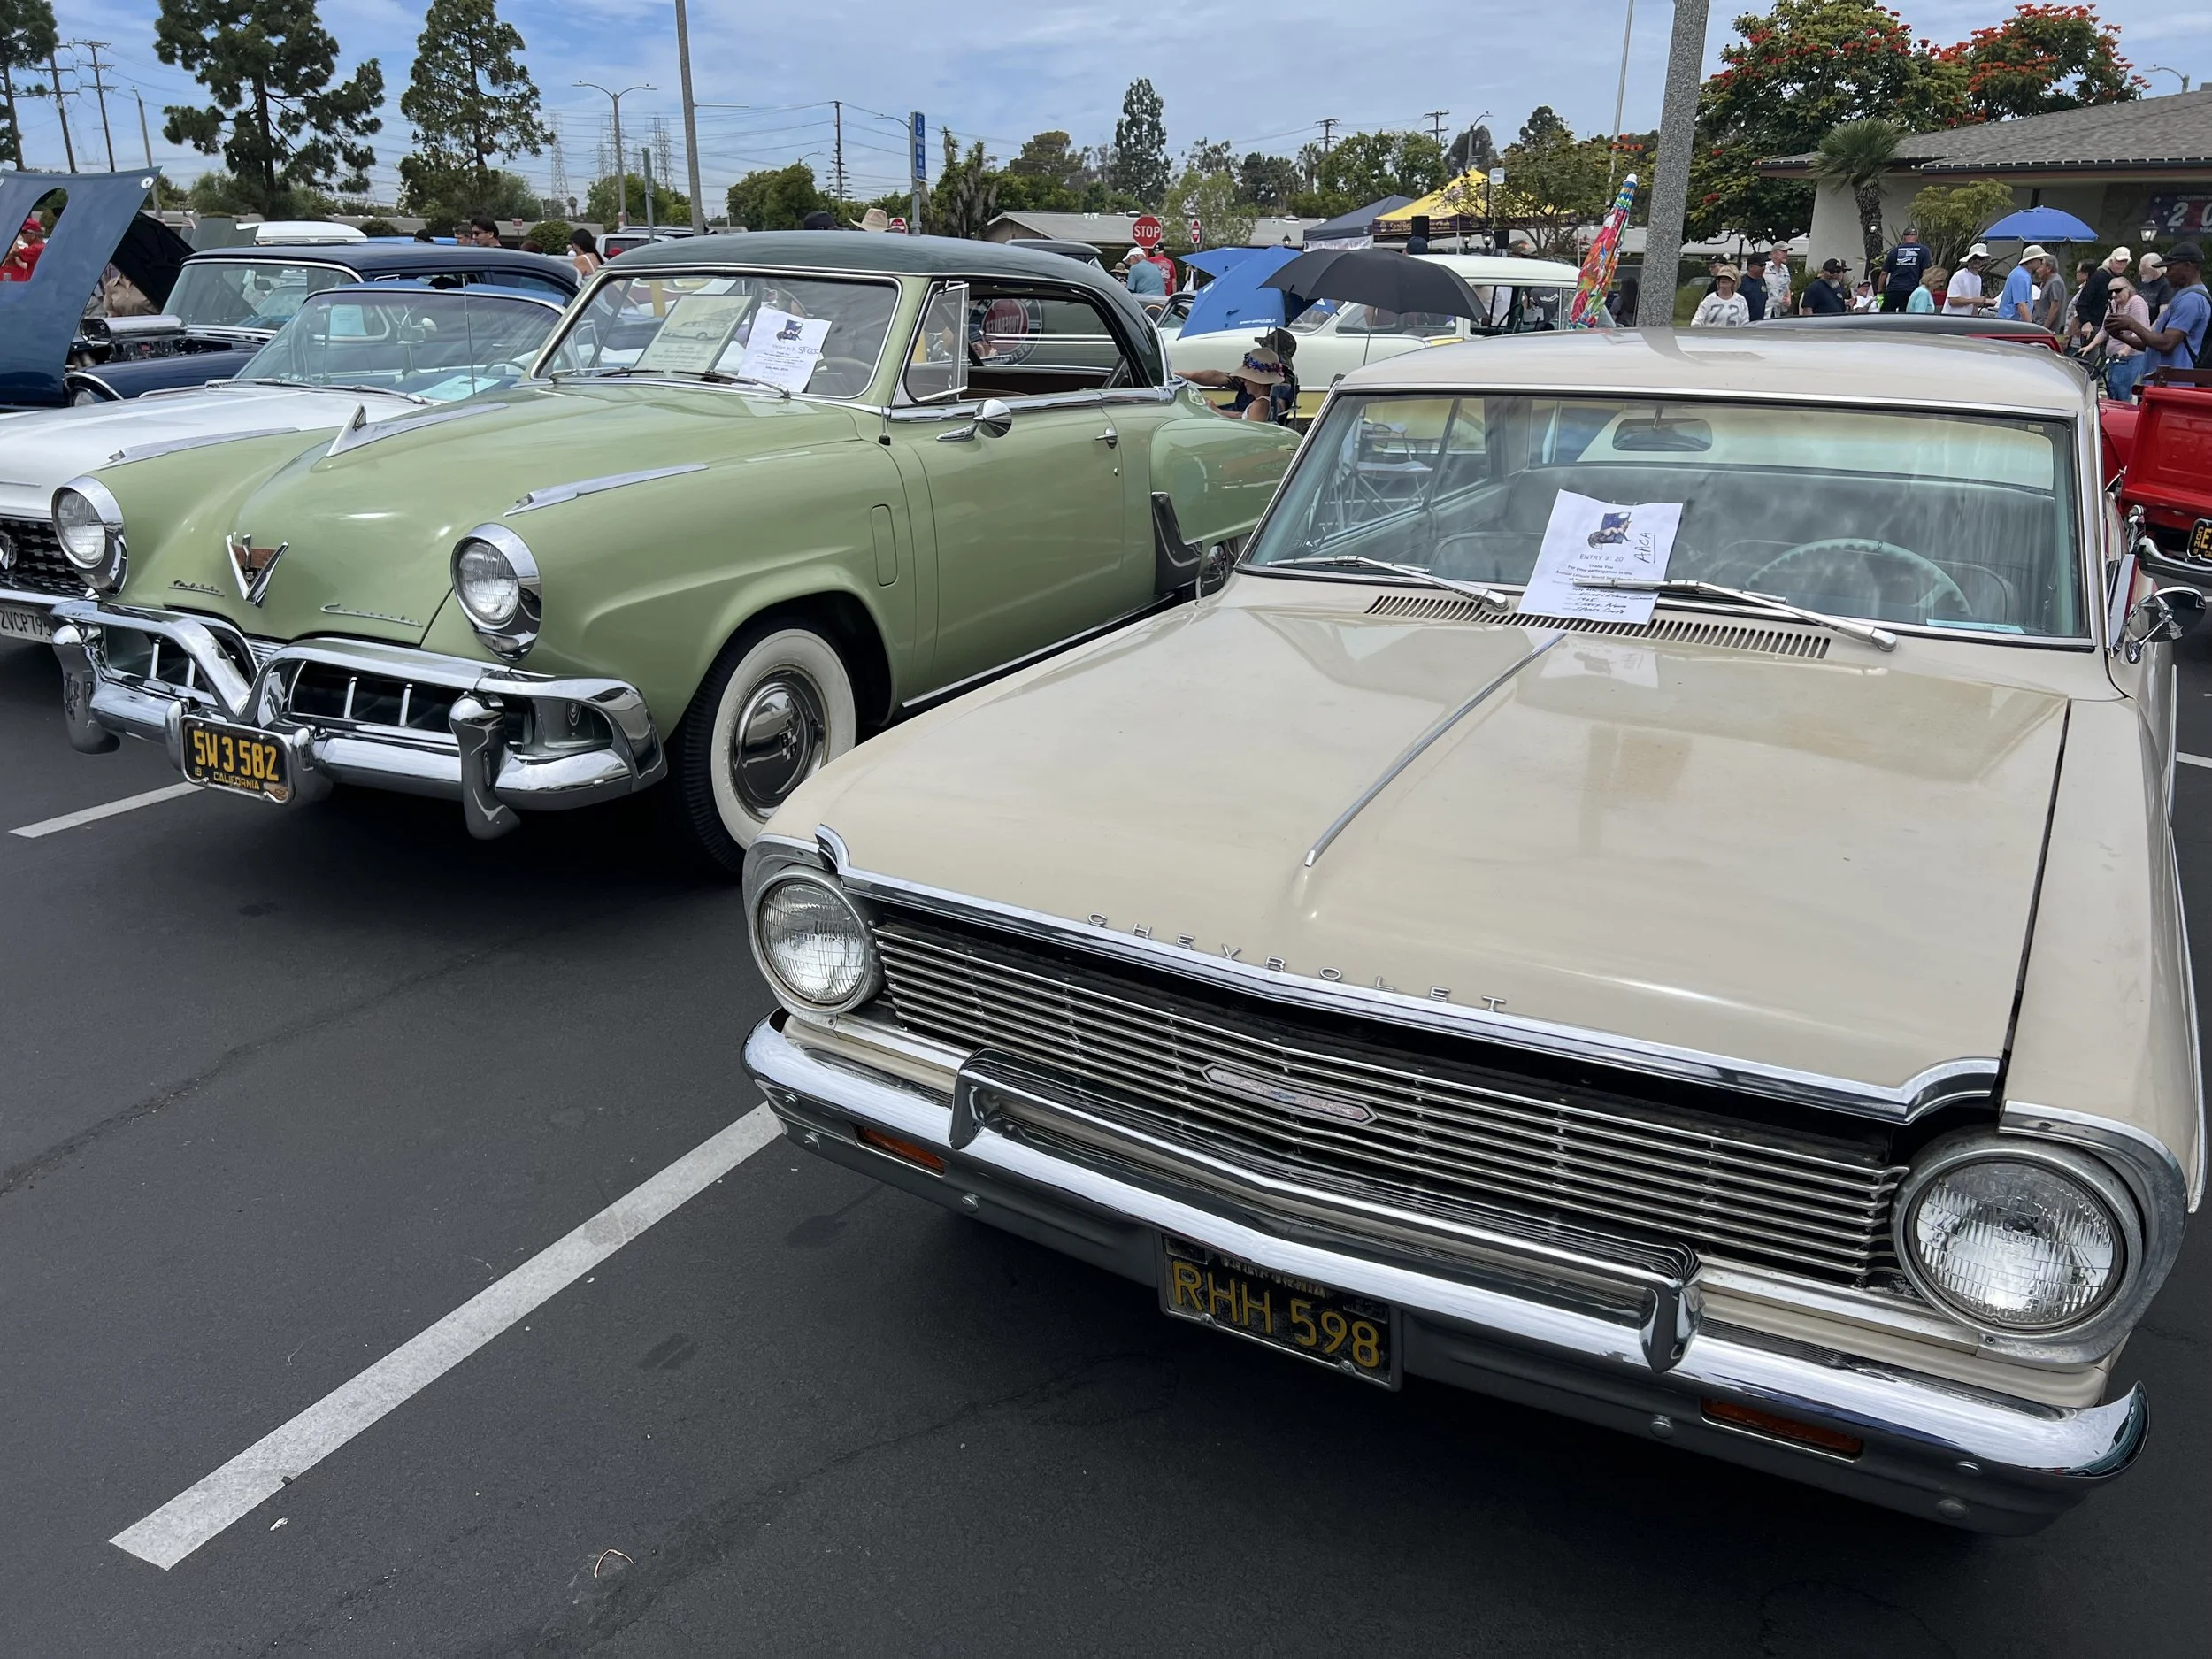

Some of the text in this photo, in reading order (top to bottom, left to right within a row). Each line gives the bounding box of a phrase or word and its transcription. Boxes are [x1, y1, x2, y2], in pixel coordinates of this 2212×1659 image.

[1134, 226, 1161, 238] STOP
[213, 771, 261, 790] CALIFORNIA
[238, 739, 280, 781] 582
[1087, 912, 1507, 1012] CHEVROLET
[1171, 1260, 1380, 1369] RHH 598
